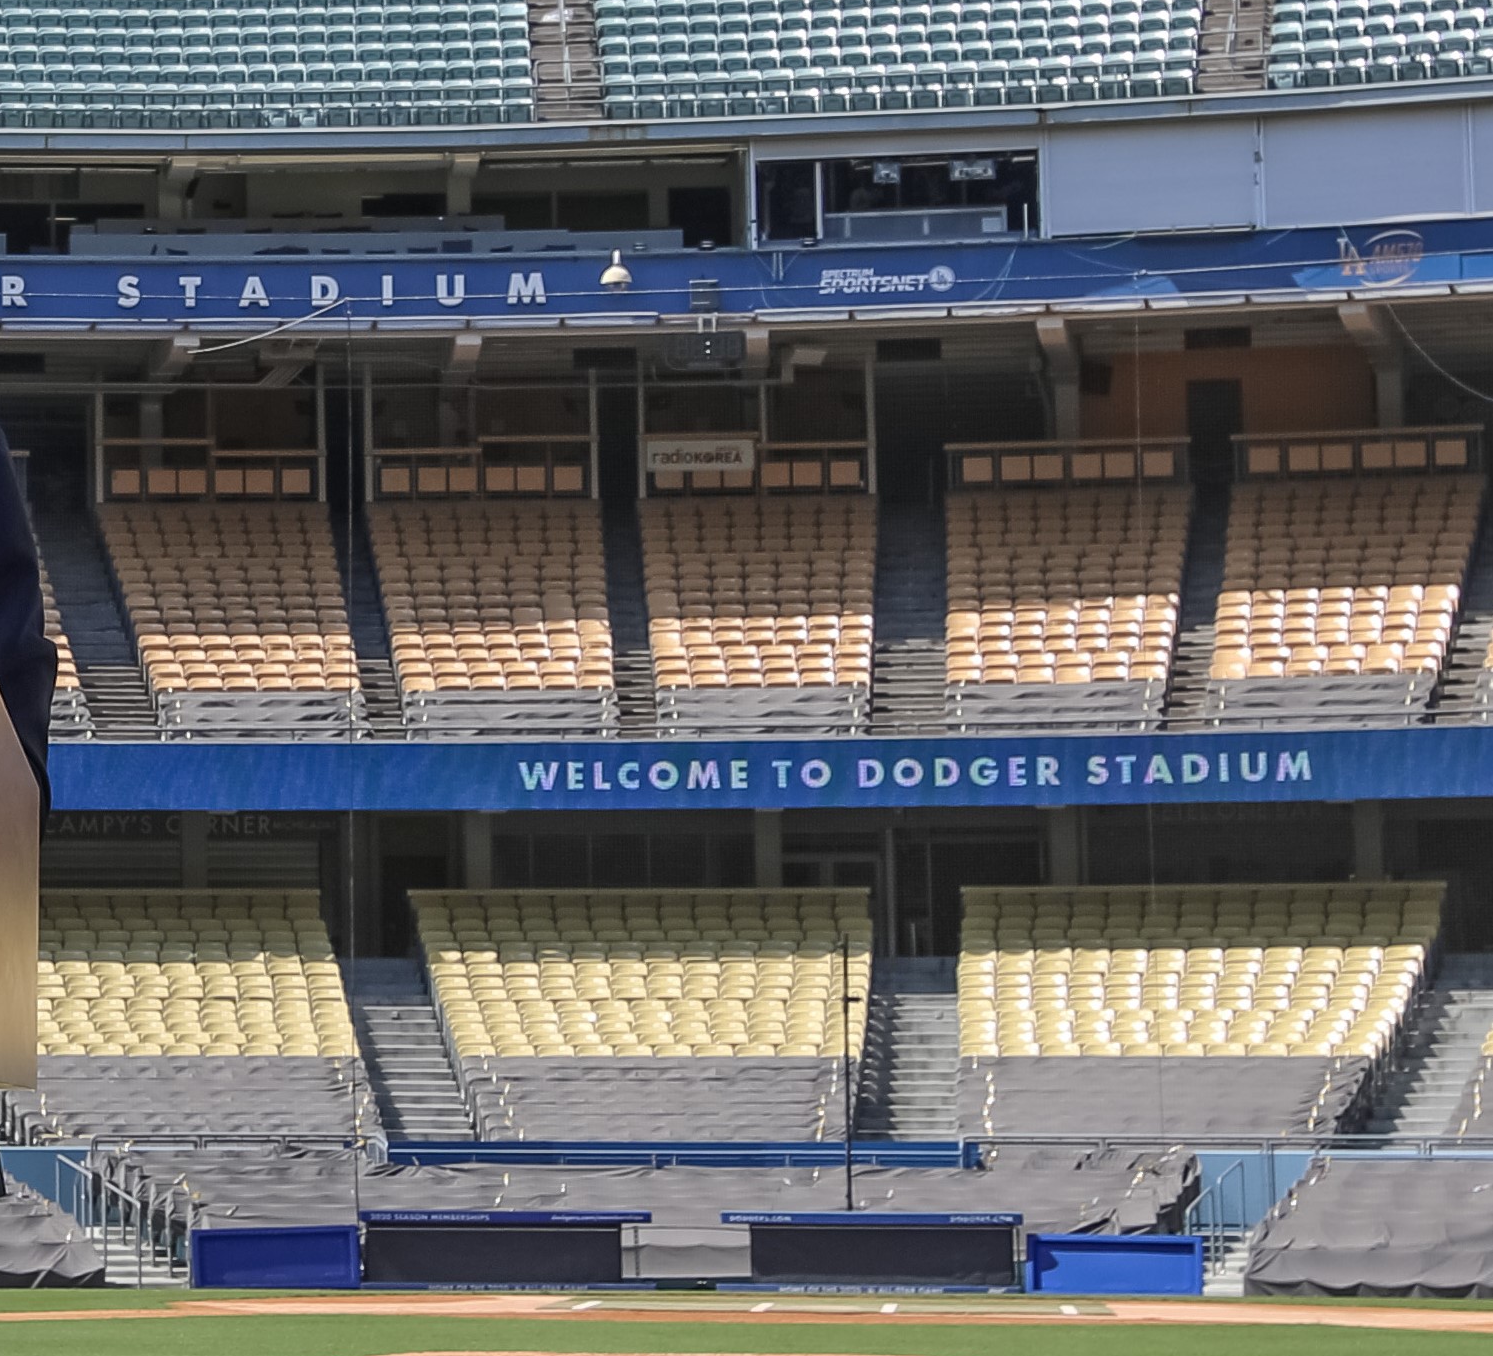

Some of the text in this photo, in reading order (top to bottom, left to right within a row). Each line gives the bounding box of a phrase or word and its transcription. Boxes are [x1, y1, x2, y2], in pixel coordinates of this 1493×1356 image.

[818, 274, 929, 295] SPORTSNET
[821, 268, 874, 279] SPECTRUM
[117, 272, 547, 308] STADIUM
[518, 750, 1313, 791] WELCOME TO DODGER STADIUM
